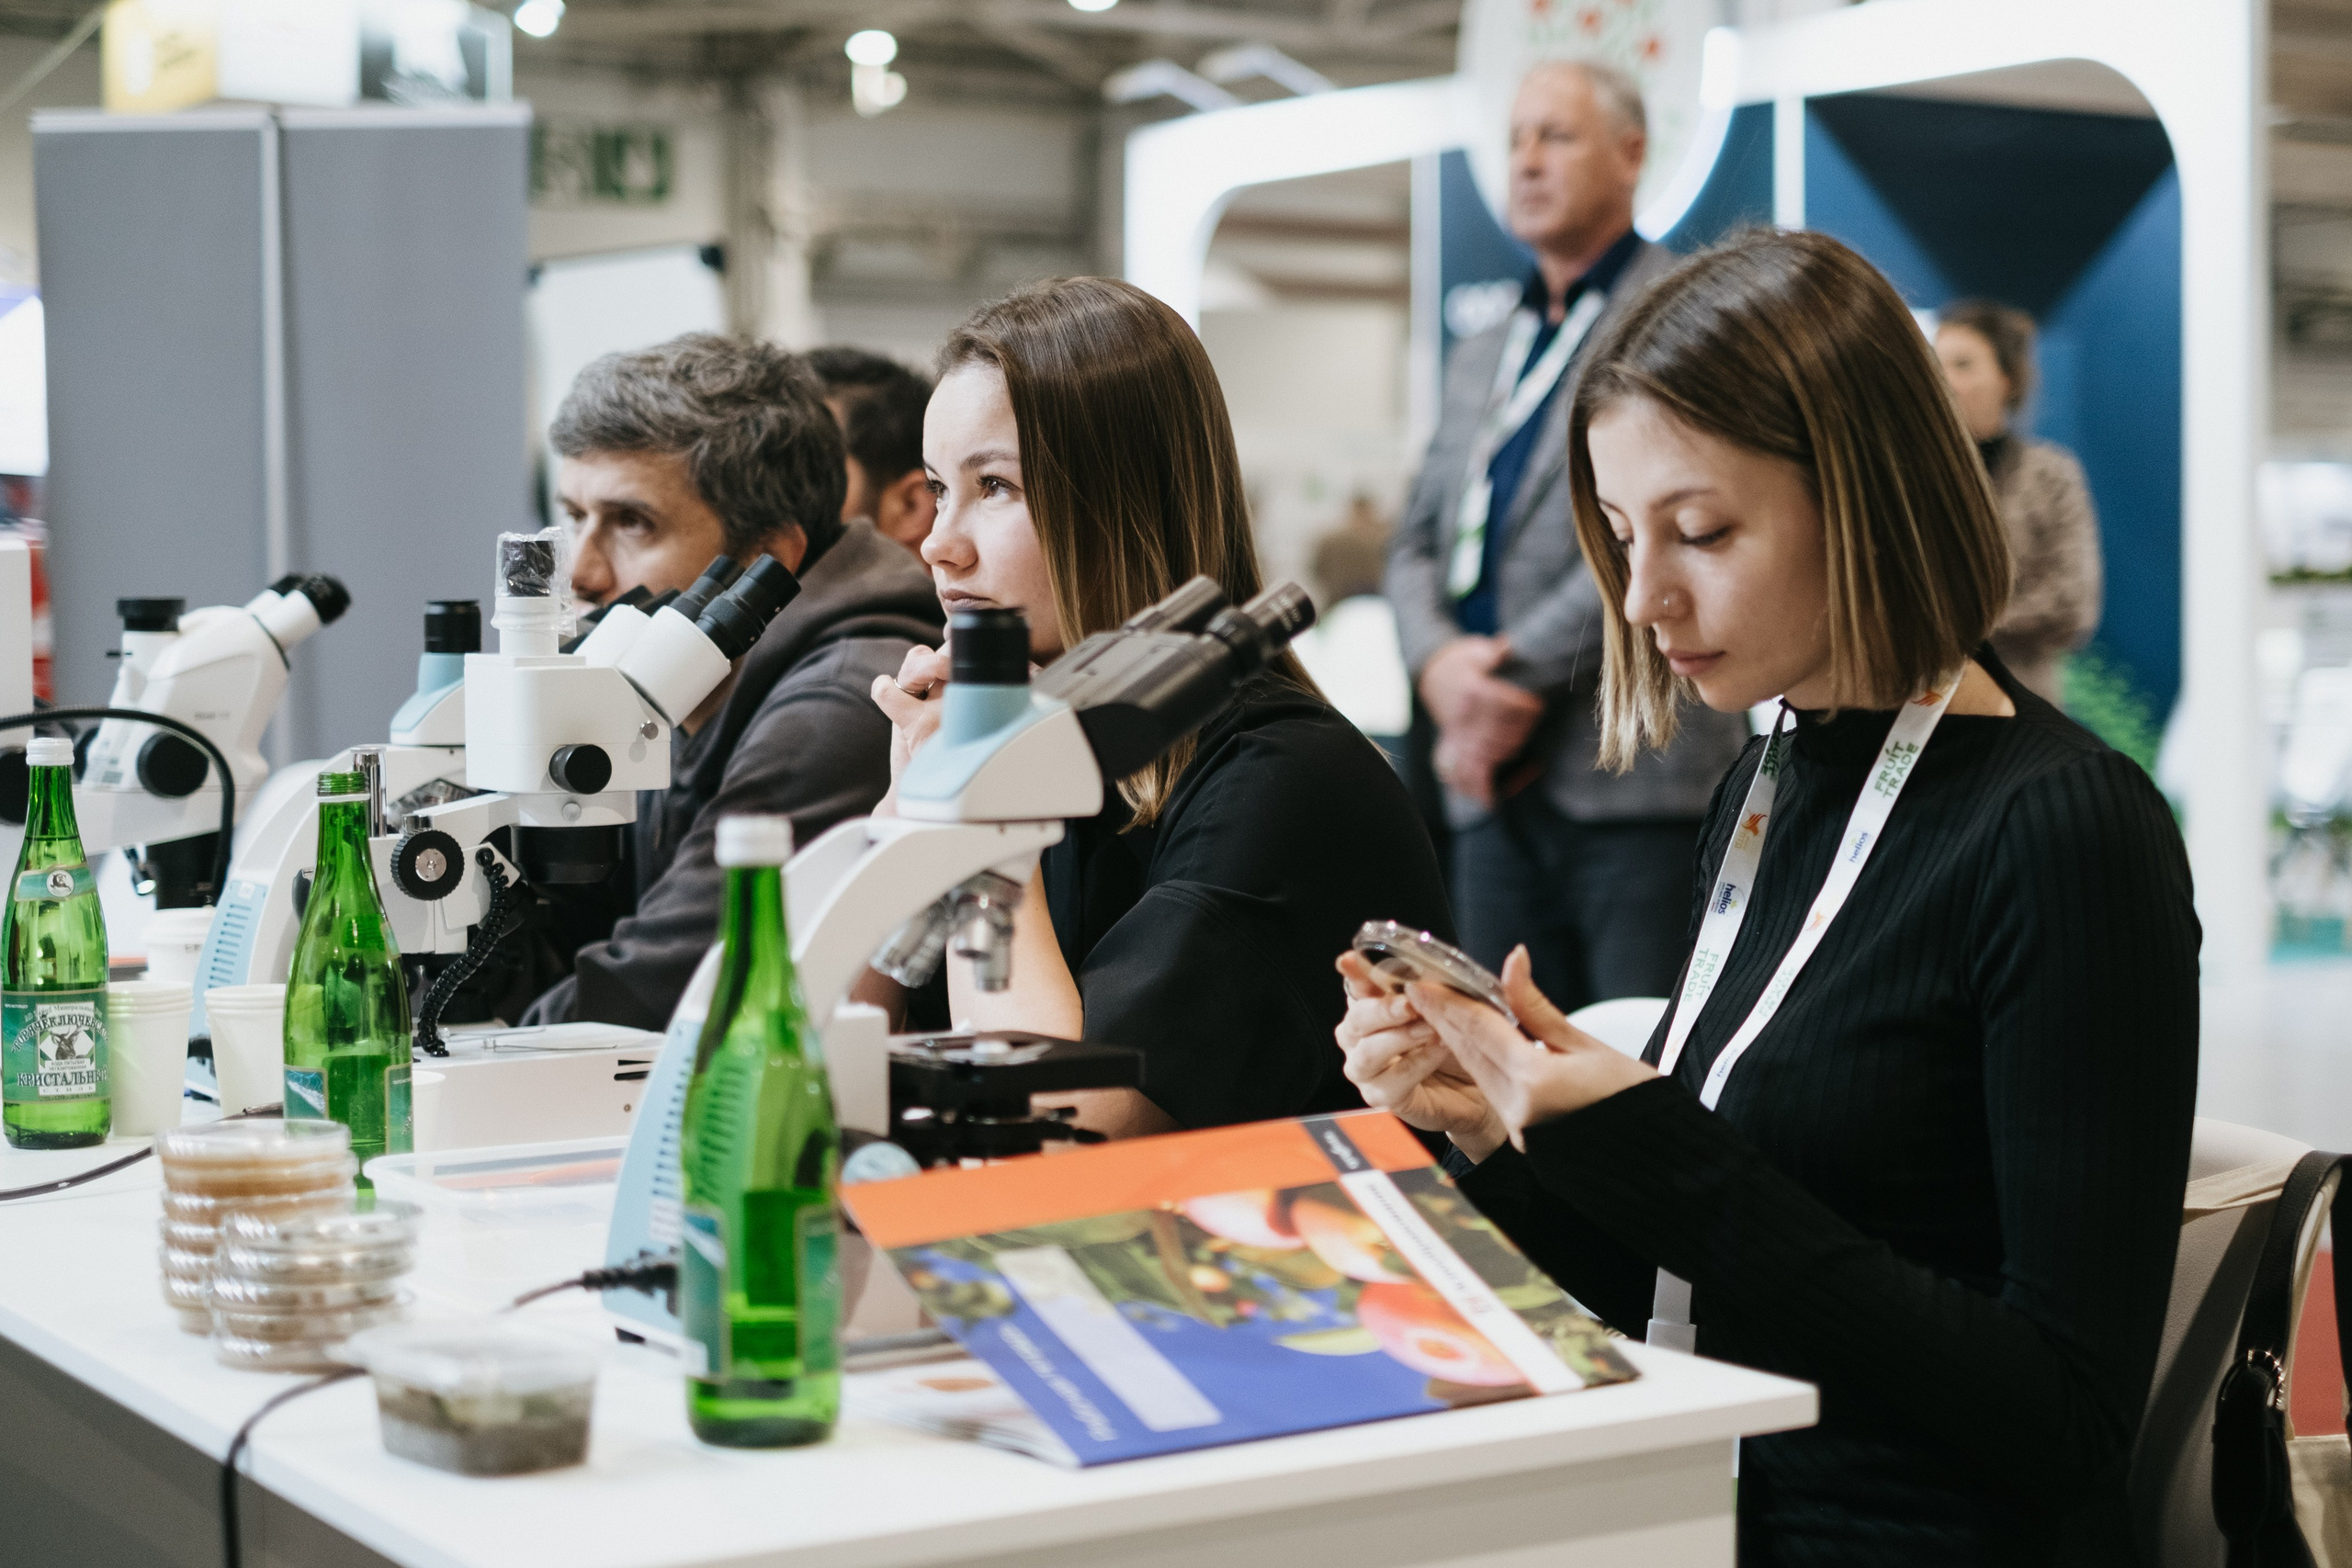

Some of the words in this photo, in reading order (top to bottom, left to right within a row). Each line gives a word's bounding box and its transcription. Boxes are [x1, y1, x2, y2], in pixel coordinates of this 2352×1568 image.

[1883, 742, 1918, 798] TRADE
[1849, 830, 1868, 863] helios
[1717, 883, 1736, 915] helios
[1683, 948, 1709, 1003] TRADE
[17, 1066, 107, 1087] КРИСТАЛЬНЫЙ
